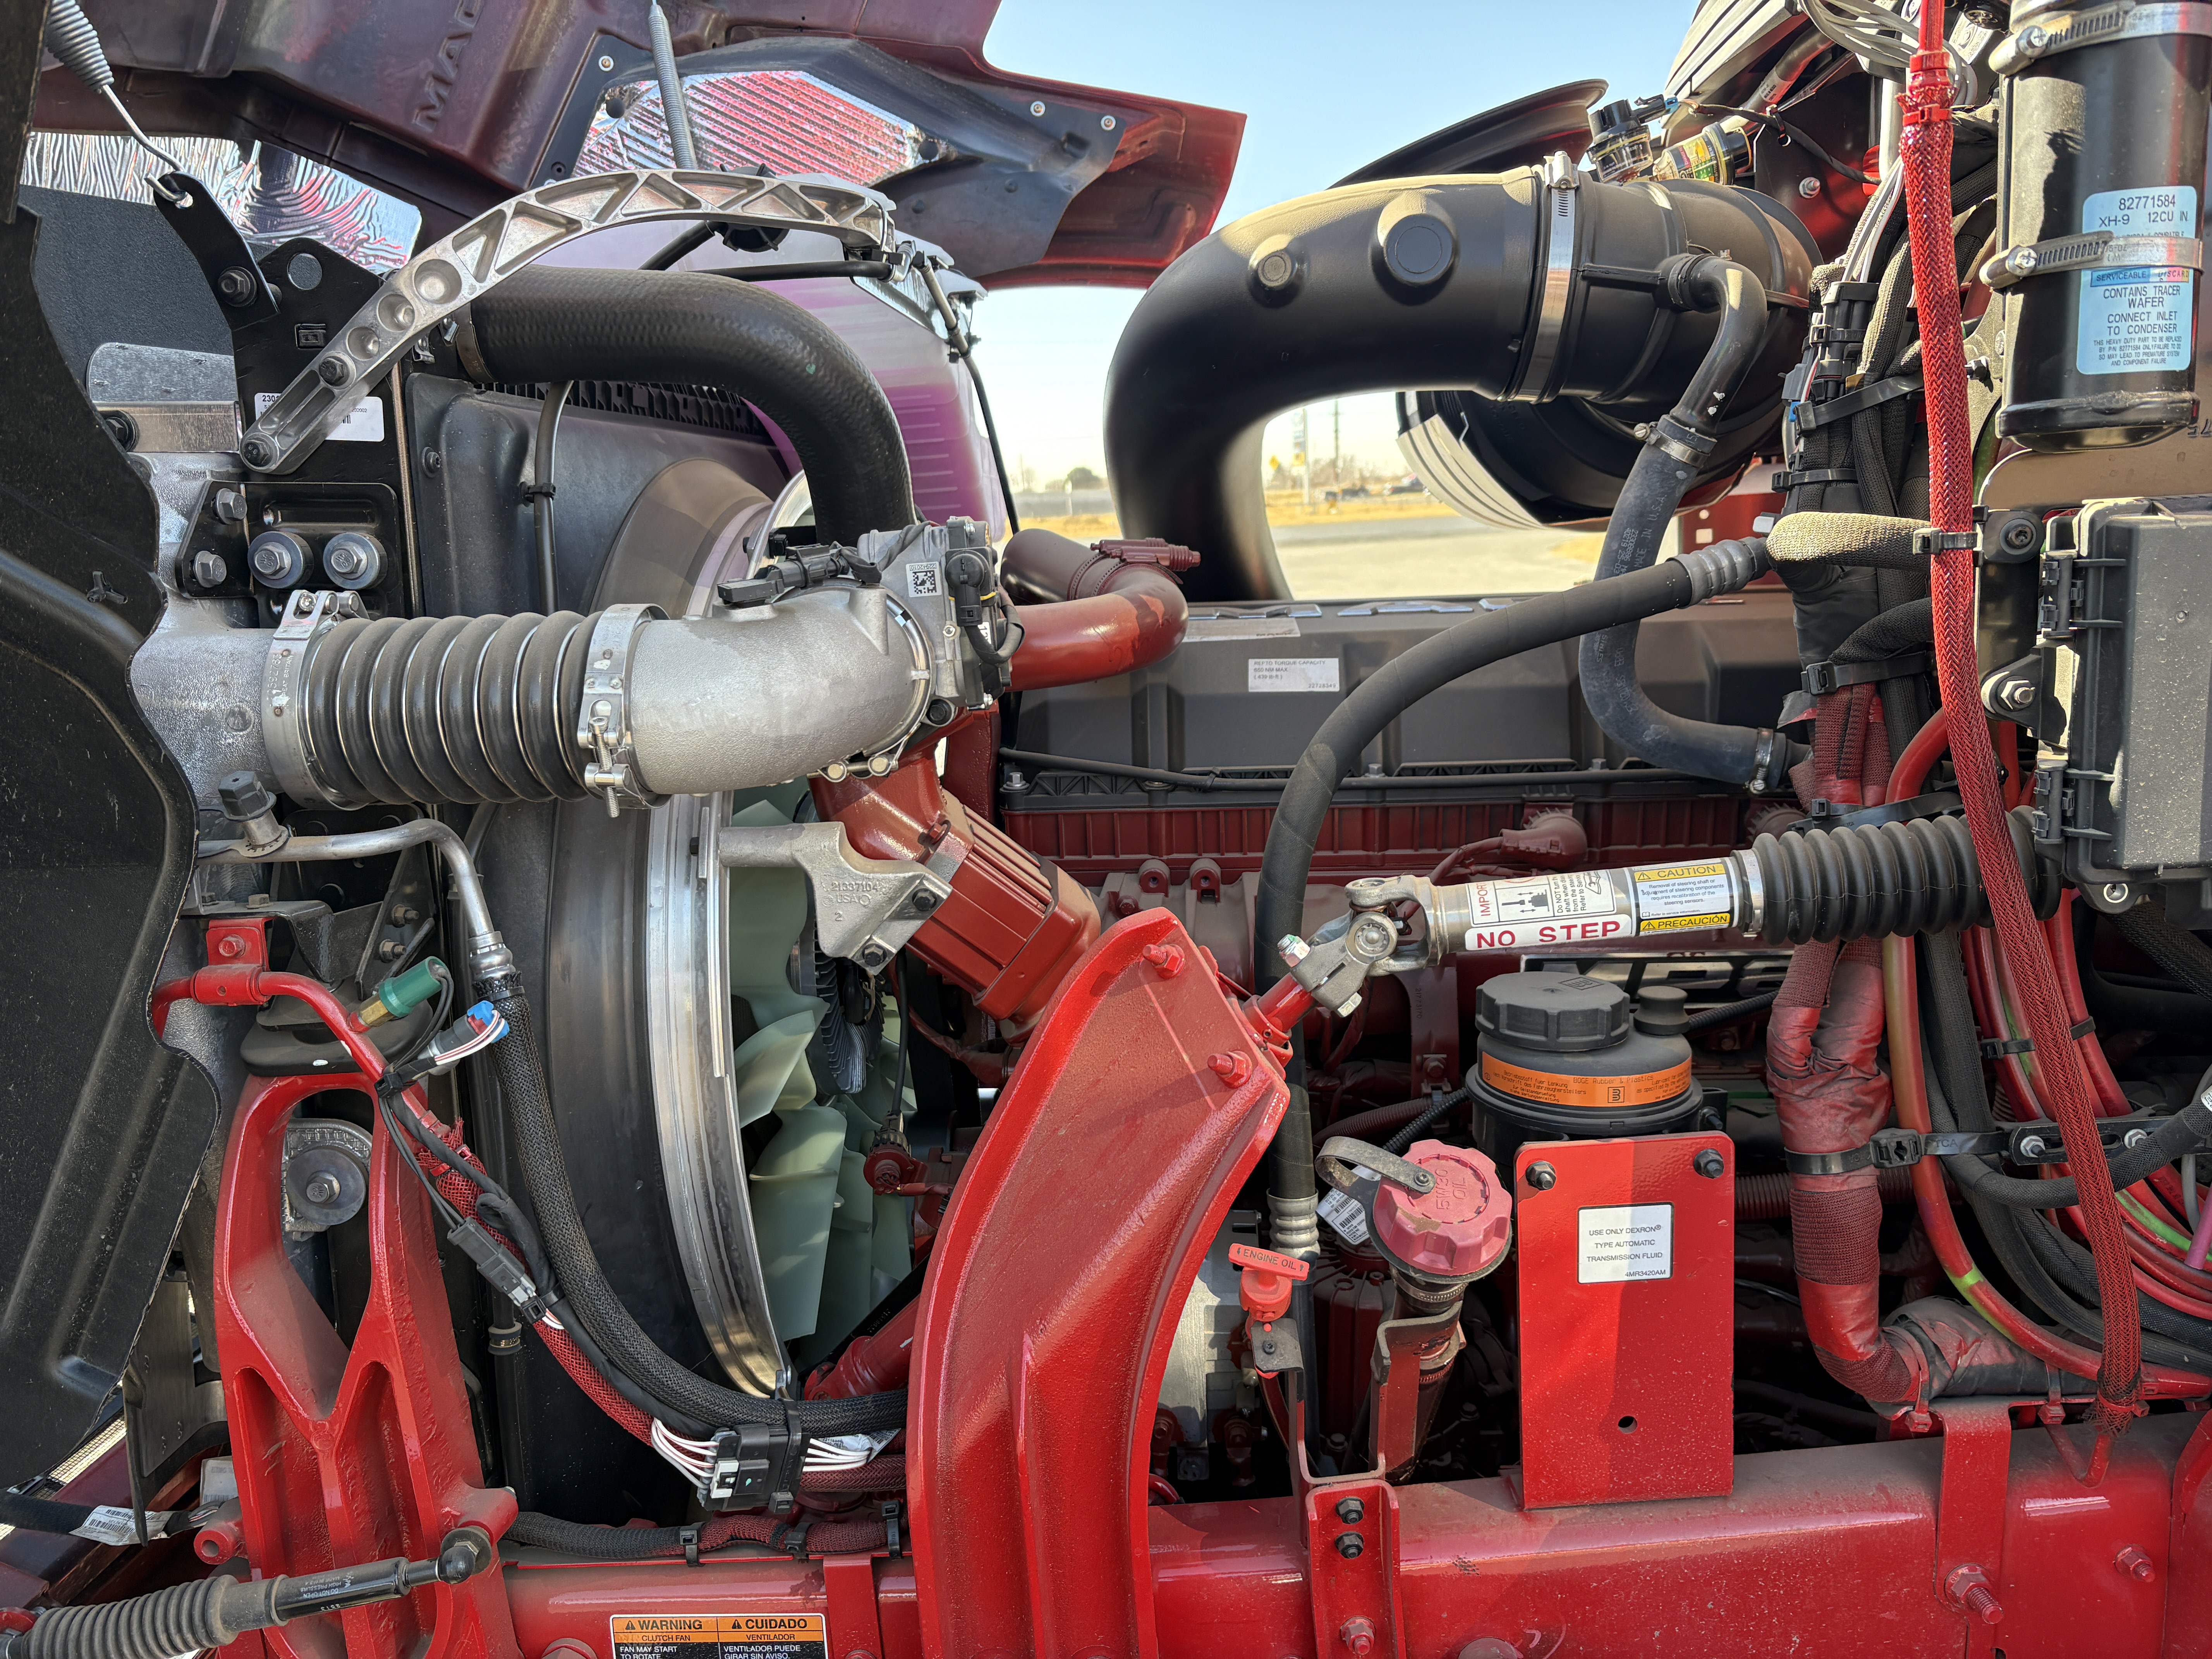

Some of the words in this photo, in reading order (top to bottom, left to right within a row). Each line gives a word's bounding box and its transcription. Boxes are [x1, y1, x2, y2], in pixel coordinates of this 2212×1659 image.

[2119, 194, 2176, 211] 82771584
[2099, 214, 2130, 228] XH-9
[2148, 211, 2174, 223] 12CU
[2096, 272, 2146, 281] SERVICEABLE
[2104, 286, 2147, 299] CONTAINS
[2154, 285, 2180, 296] TRACER
[2128, 297, 2164, 308] WAFER
[2108, 312, 2151, 323] CONNECT
[2157, 311, 2177, 321] INLET
[2107, 326, 2120, 336] TO
[2127, 323, 2177, 334] CONDENSER
[1634, 548, 1647, 568] MADE
[1641, 529, 1653, 541] IN
[1647, 494, 1667, 521] U.S.A.
[1657, 865, 1716, 878] CAUTION
[837, 892, 859, 903] USA
[835, 910, 843, 921] 2
[1557, 905, 1563, 913] Do
[1658, 915, 1728, 928] PRECAUCIÓN
[1477, 930, 1516, 948] NO
[1539, 921, 1620, 943] STEP
[1547, 1080, 1568, 1089] Lenkung
[1935, 1139, 1958, 1148] TCA
[1435, 1169, 1450, 1209] 5W30
[1452, 1178, 1467, 1199] OIL
[1243, 1249, 1279, 1265] ENGINE
[1281, 1259, 1297, 1270] OIL
[638, 1620, 702, 1630] WARNING
[745, 1619, 807, 1629] CUIDADO
